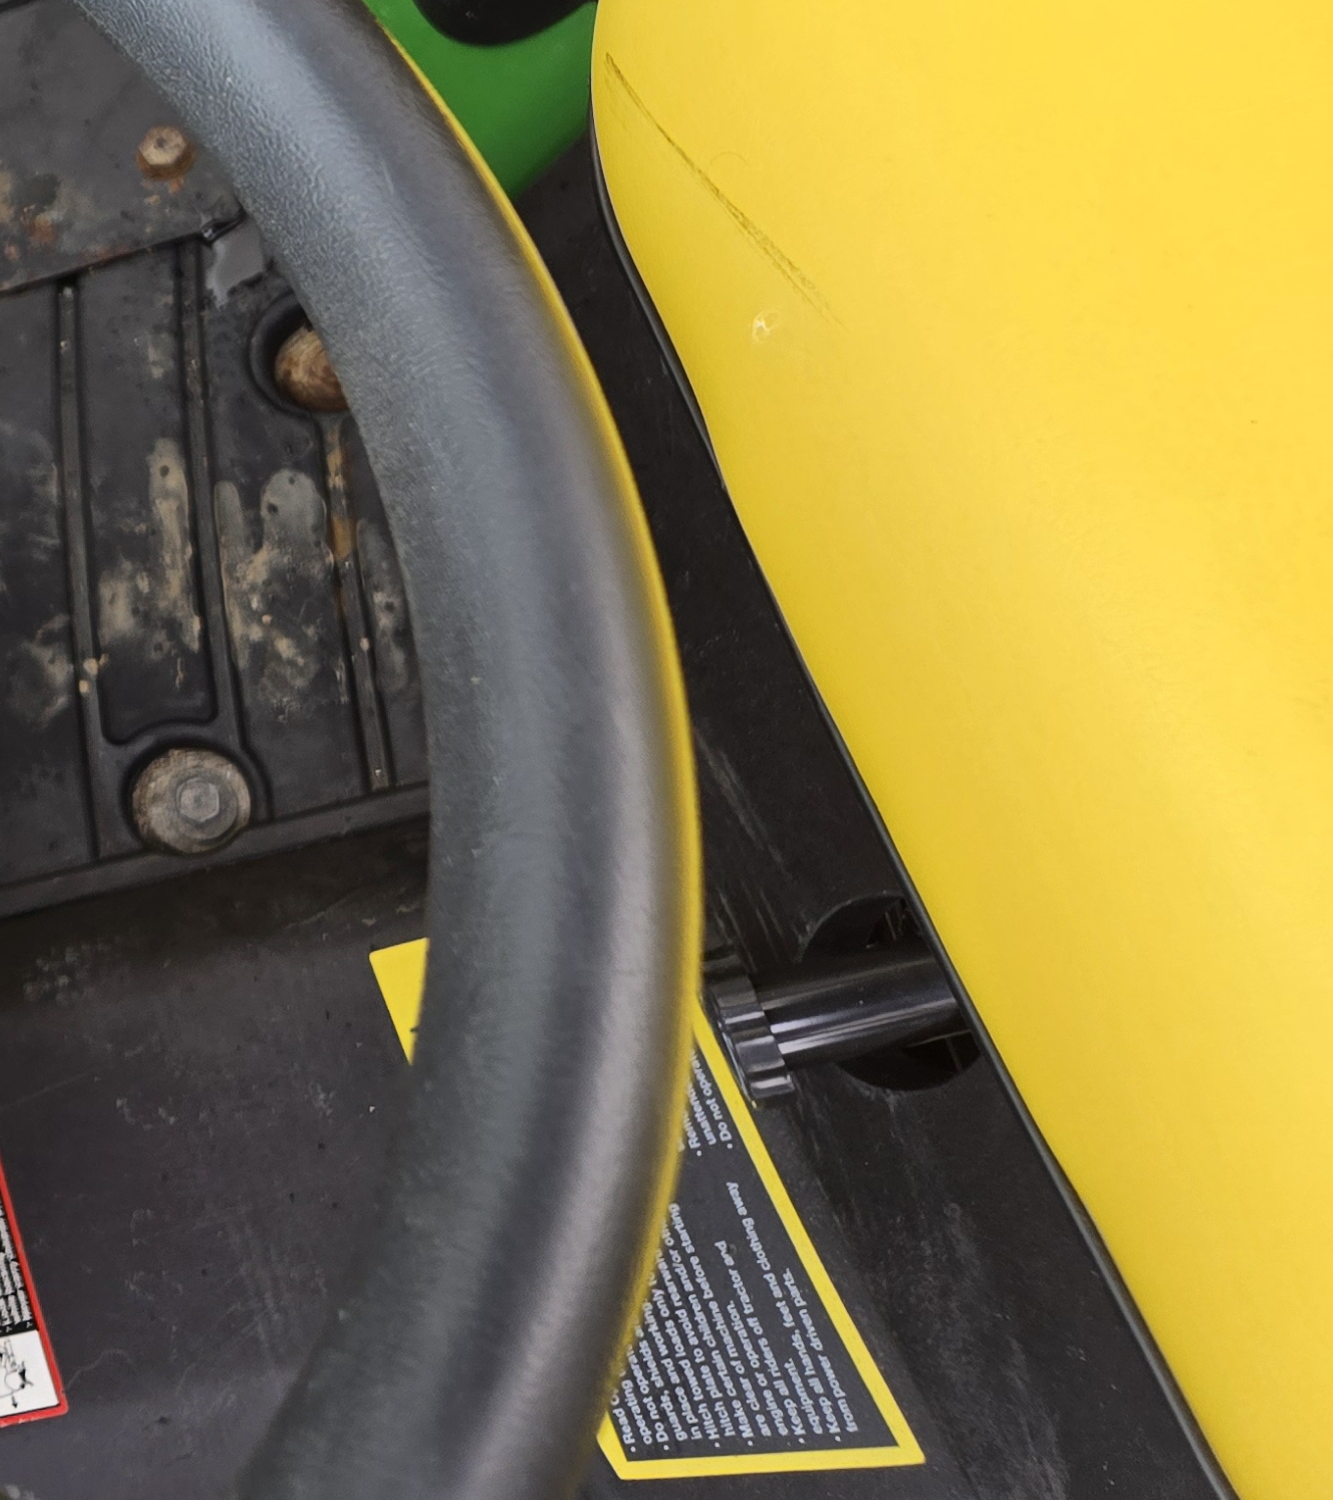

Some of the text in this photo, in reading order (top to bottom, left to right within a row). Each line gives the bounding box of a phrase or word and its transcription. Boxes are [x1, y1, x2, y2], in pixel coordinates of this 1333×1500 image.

[705, 1097, 722, 1120] not
[717, 1121, 732, 1141] Do
[668, 1248, 694, 1291] and/or
[669, 1203, 771, 1436] are clear of machine before starting
[687, 1293, 716, 1347] children
[725, 1181, 841, 1433] Keep all hands, feet and clothing away
[656, 1251, 735, 1436] hitch plate to avoid rearwar
[714, 1240, 806, 1435] Keep all riders off tractor and
[782, 1267, 858, 1432] from power driven parts.
[651, 1288, 720, 1439] Hitch towed loads only
[660, 1357, 680, 1383] and
[710, 1349, 737, 1396] certain
[726, 1299, 788, 1436] engine or operation.
[621, 1379, 652, 1444] operating
[638, 1339, 688, 1441] guards, shields
[642, 1395, 659, 1419] not
[674, 1386, 698, 1424] place
[783, 1357, 823, 1434] equipment.
[612, 1407, 635, 1444] Read
[654, 1421, 669, 1442] Do
[690, 1425, 702, 1439] in
[731, 1399, 754, 1438] Make
